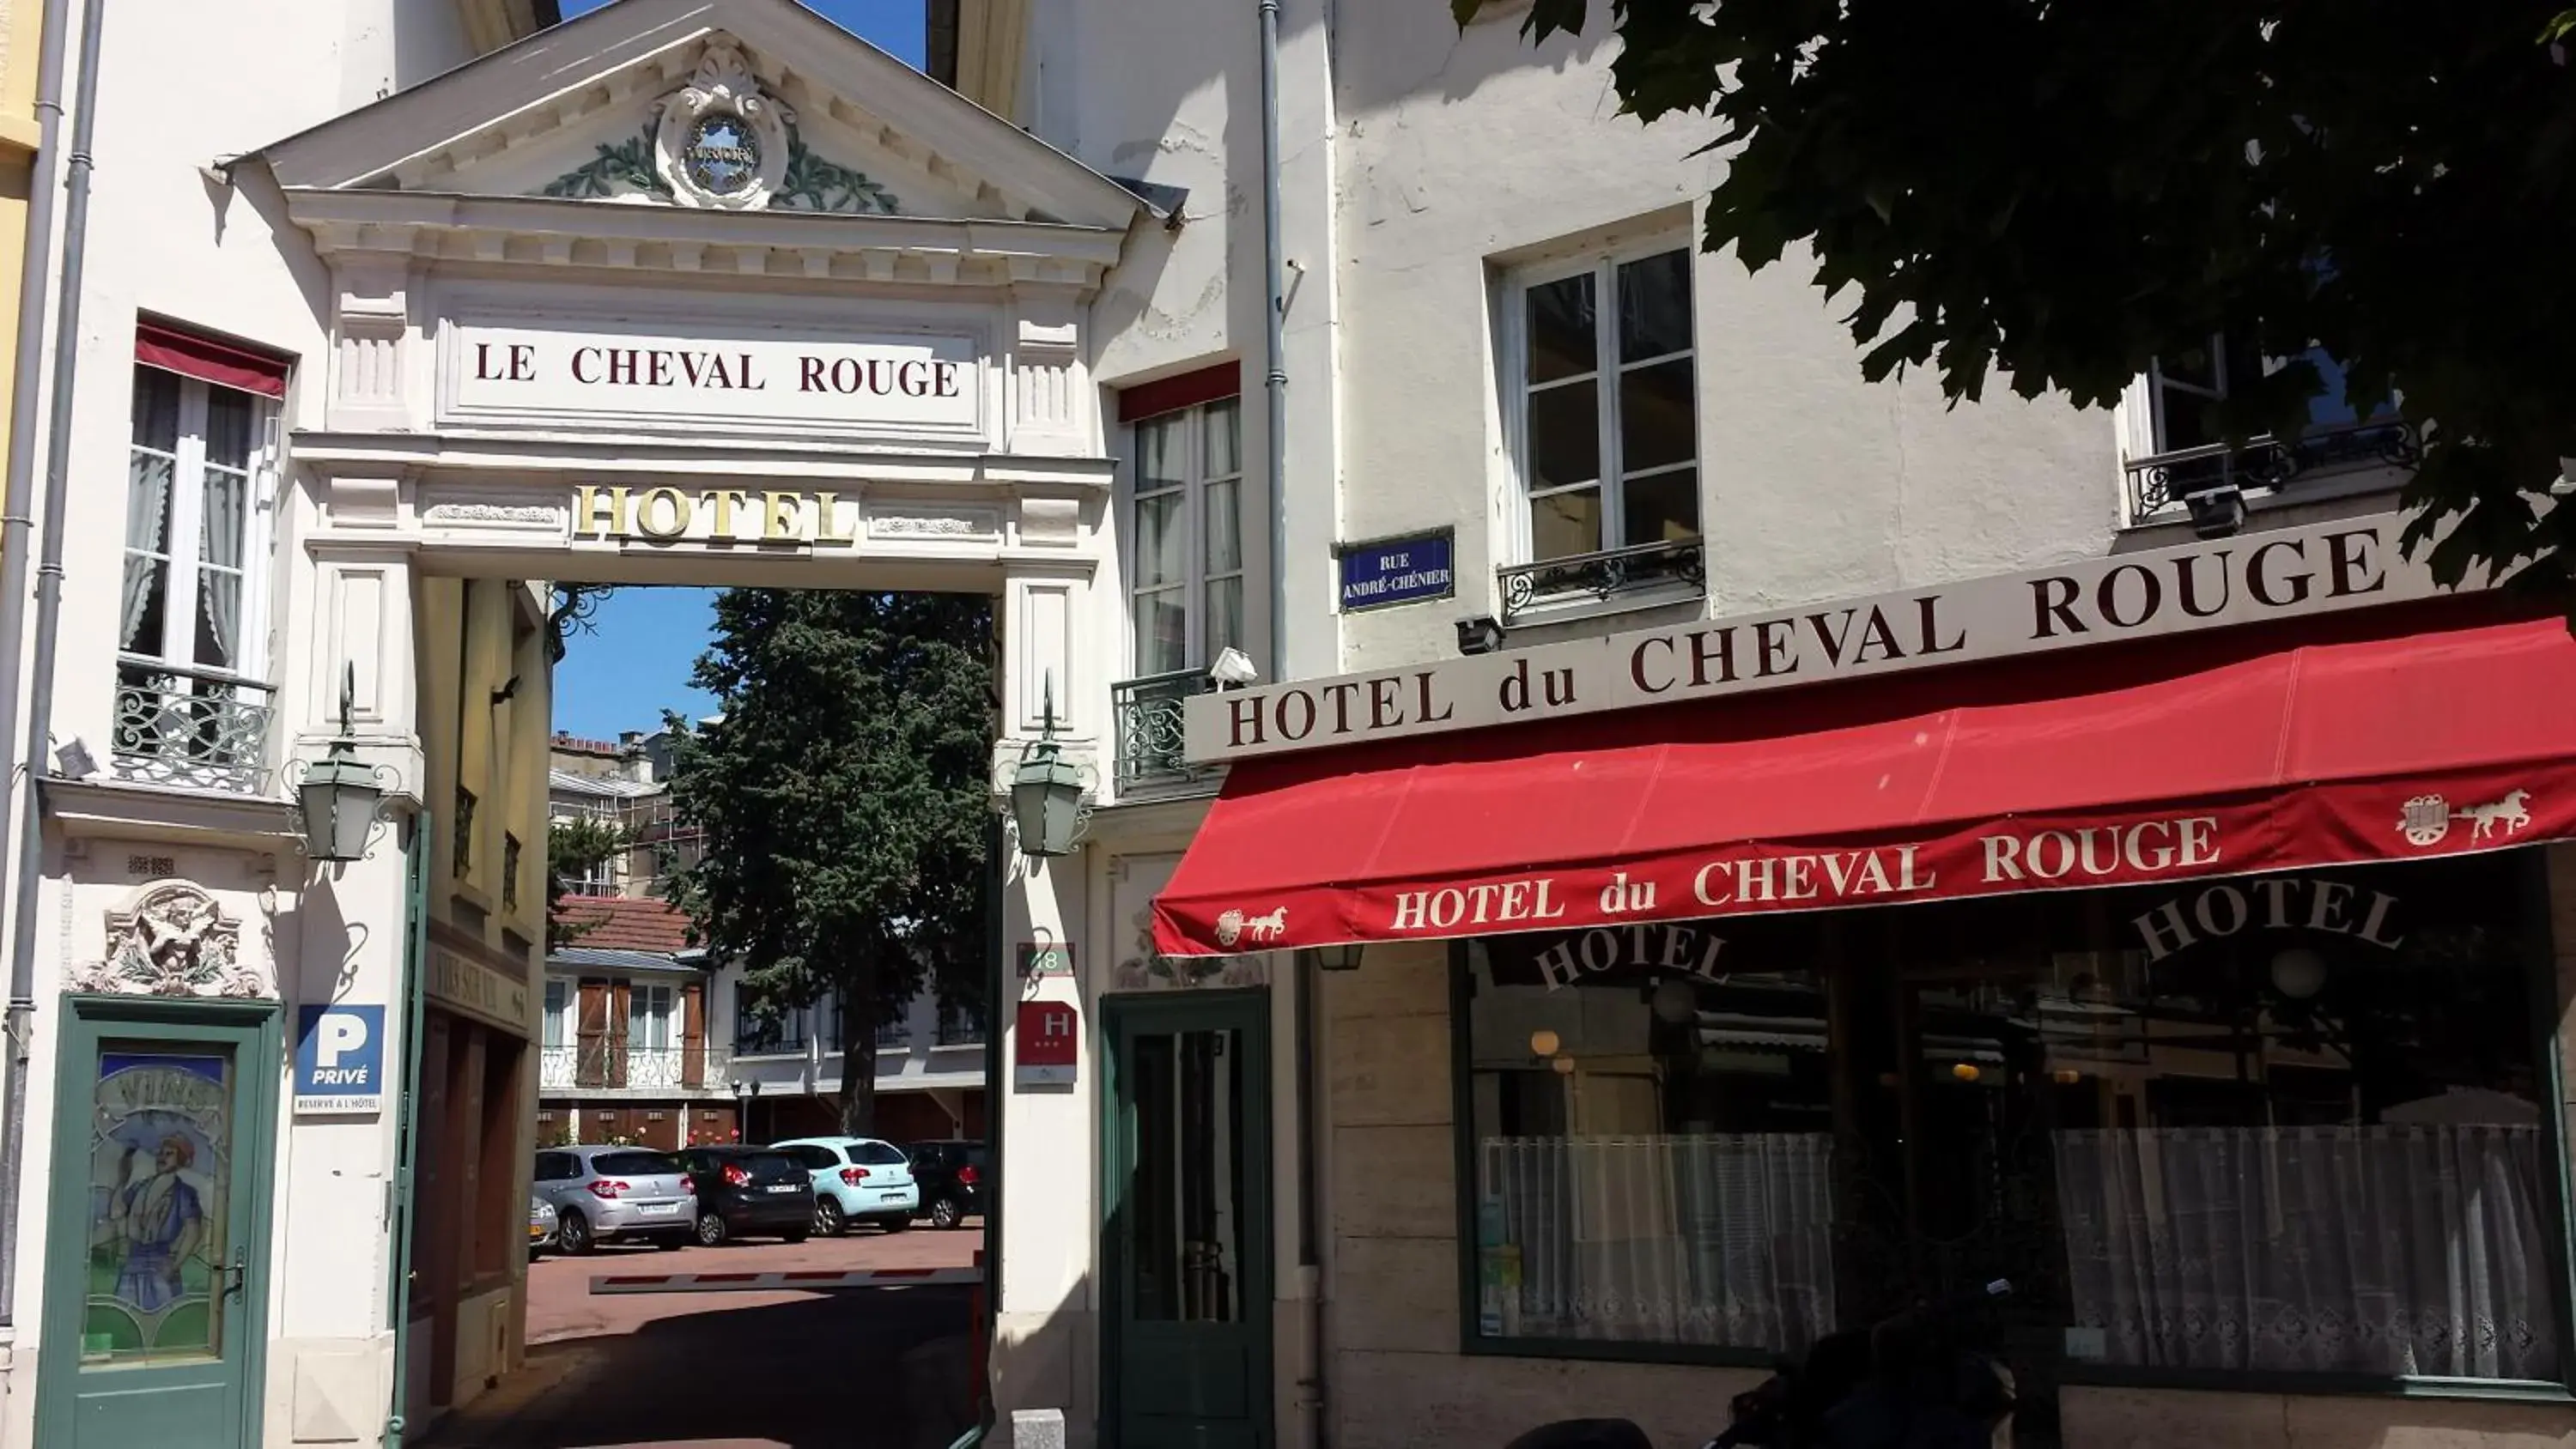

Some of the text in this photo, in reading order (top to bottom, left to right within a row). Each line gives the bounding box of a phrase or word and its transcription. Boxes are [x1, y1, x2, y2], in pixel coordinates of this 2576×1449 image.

[477, 344, 959, 397] LE CHEVAL ROUGE
[574, 485, 856, 541] HOTEL
[1343, 568, 1450, 598] ANDRÉ-CHÉNIER
[1380, 553, 1409, 571] RUE
[1227, 528, 2386, 748] HOTEL du CHEVAL ROUGE
[1389, 816, 2221, 930] HOTEL du CHEVAL ROUGE
[2131, 878, 2404, 961] HOTEL
[1533, 924, 1731, 992] HOTEL
[317, 1014, 368, 1067] P
[1045, 1013, 1069, 1036] H
[312, 1064, 368, 1085] PRIVÉ
